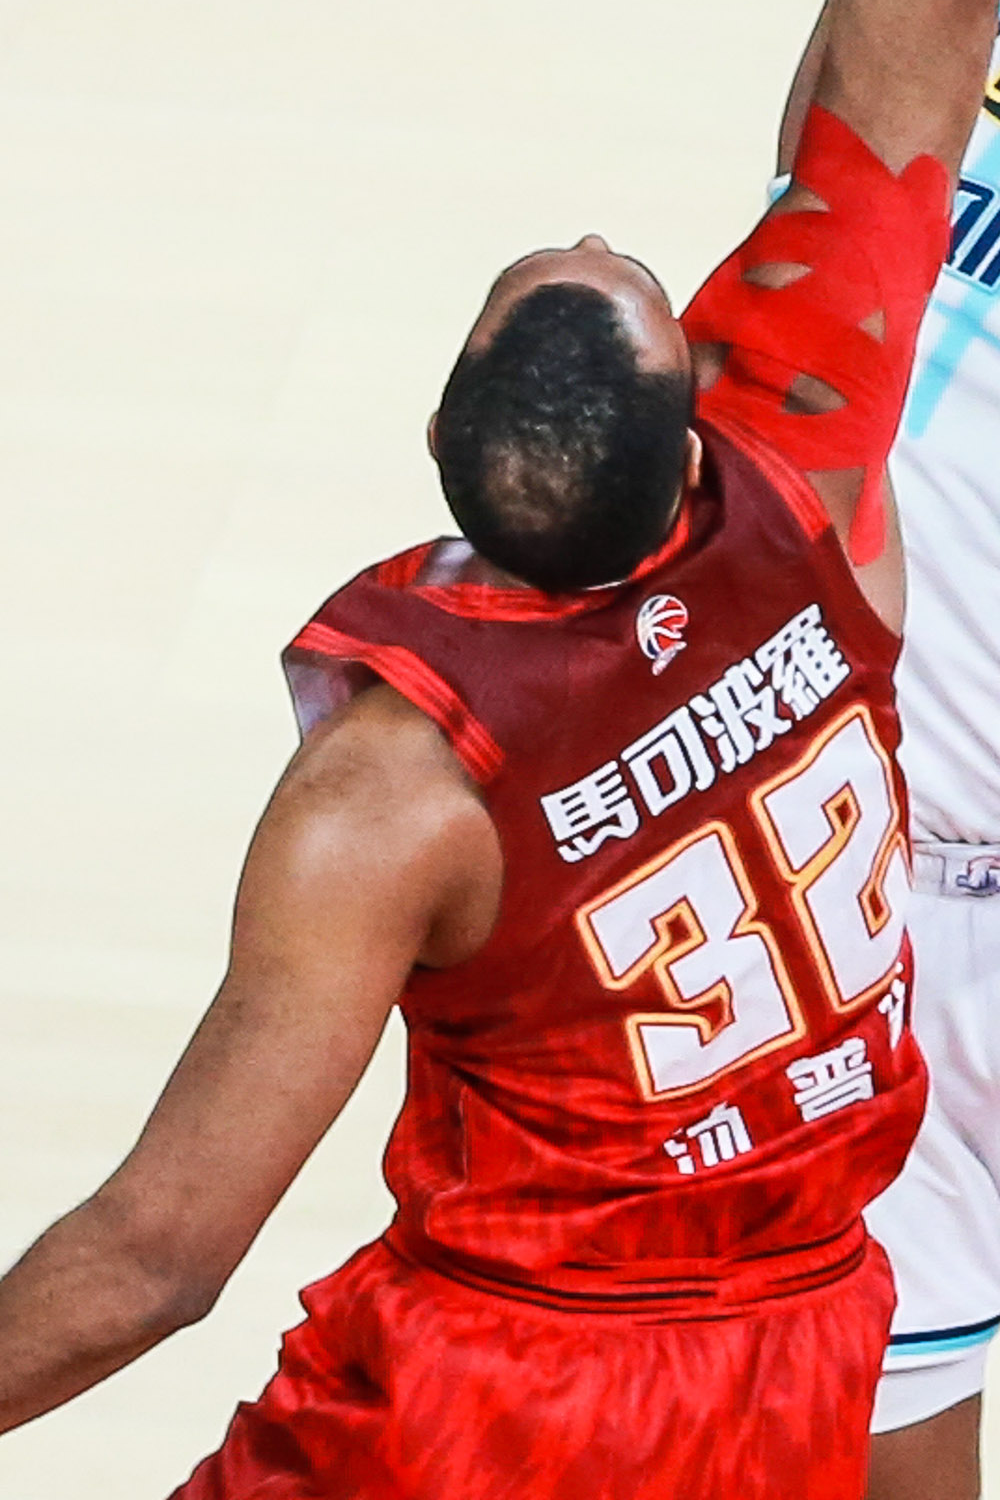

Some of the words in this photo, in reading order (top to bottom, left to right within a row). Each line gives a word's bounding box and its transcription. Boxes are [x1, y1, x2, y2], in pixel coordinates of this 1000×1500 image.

[541, 603, 851, 863] 馬可波羅
[577, 706, 906, 1102] 32
